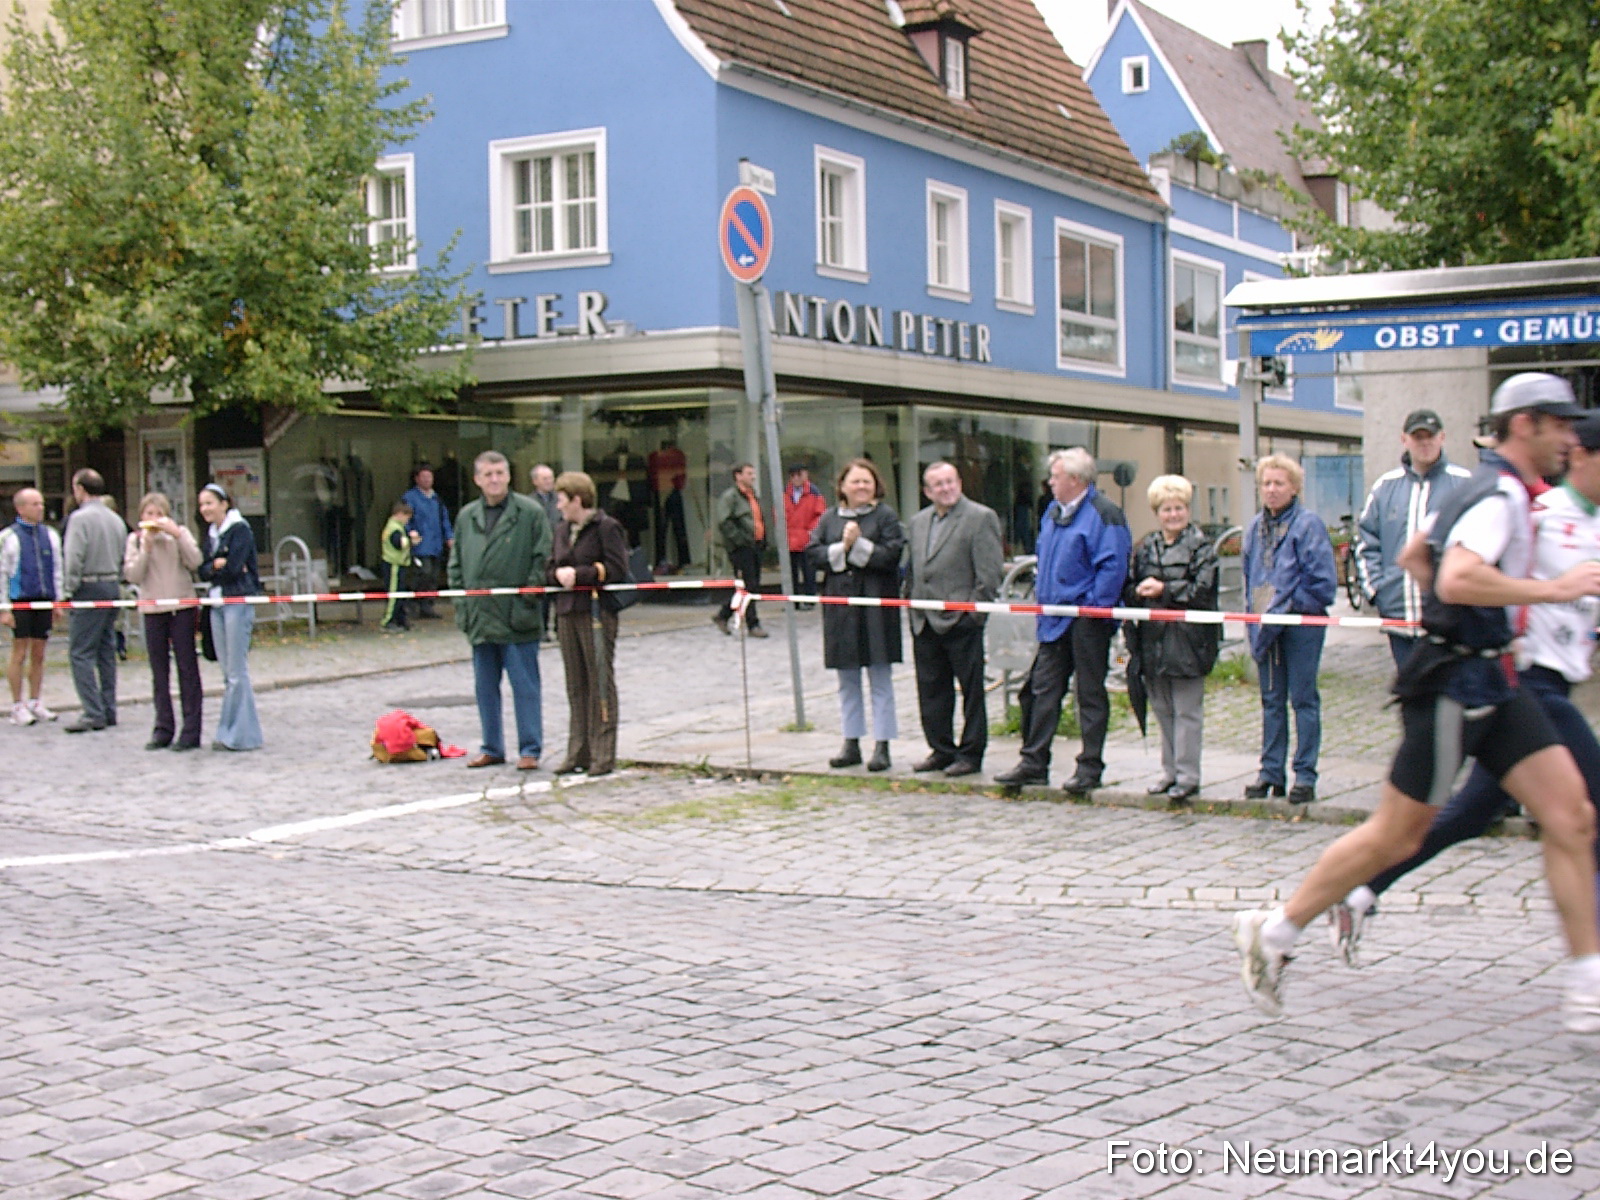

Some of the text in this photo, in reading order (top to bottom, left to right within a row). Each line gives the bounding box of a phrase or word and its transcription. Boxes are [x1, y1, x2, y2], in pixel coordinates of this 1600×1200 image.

[461, 290, 608, 341] ETER
[894, 310, 992, 363] PETER
[1375, 322, 1461, 349] OBST
